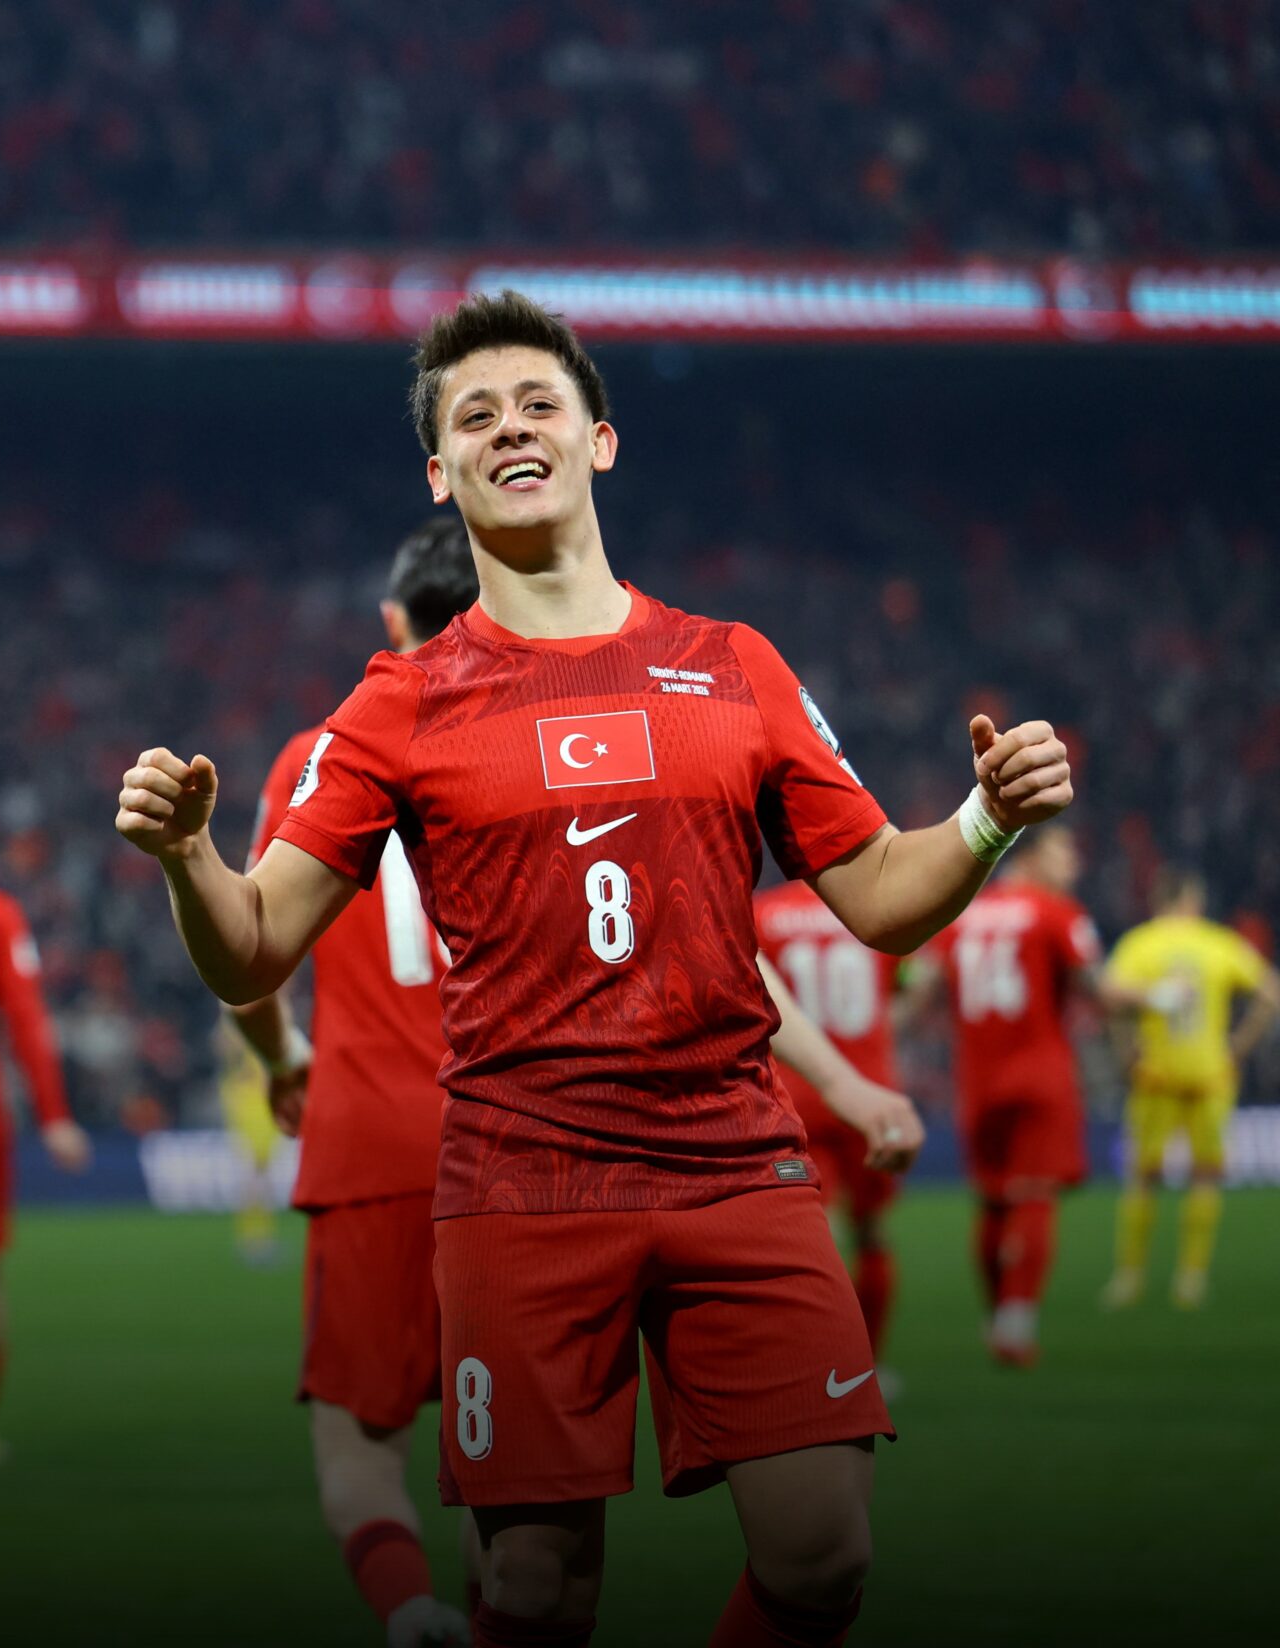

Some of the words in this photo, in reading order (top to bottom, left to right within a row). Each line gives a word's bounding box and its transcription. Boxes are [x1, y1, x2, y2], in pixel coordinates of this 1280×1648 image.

[670, 682, 691, 694] MART
[692, 685, 710, 696] 2026
[585, 860, 634, 964] 8
[456, 1357, 493, 1461] 8
